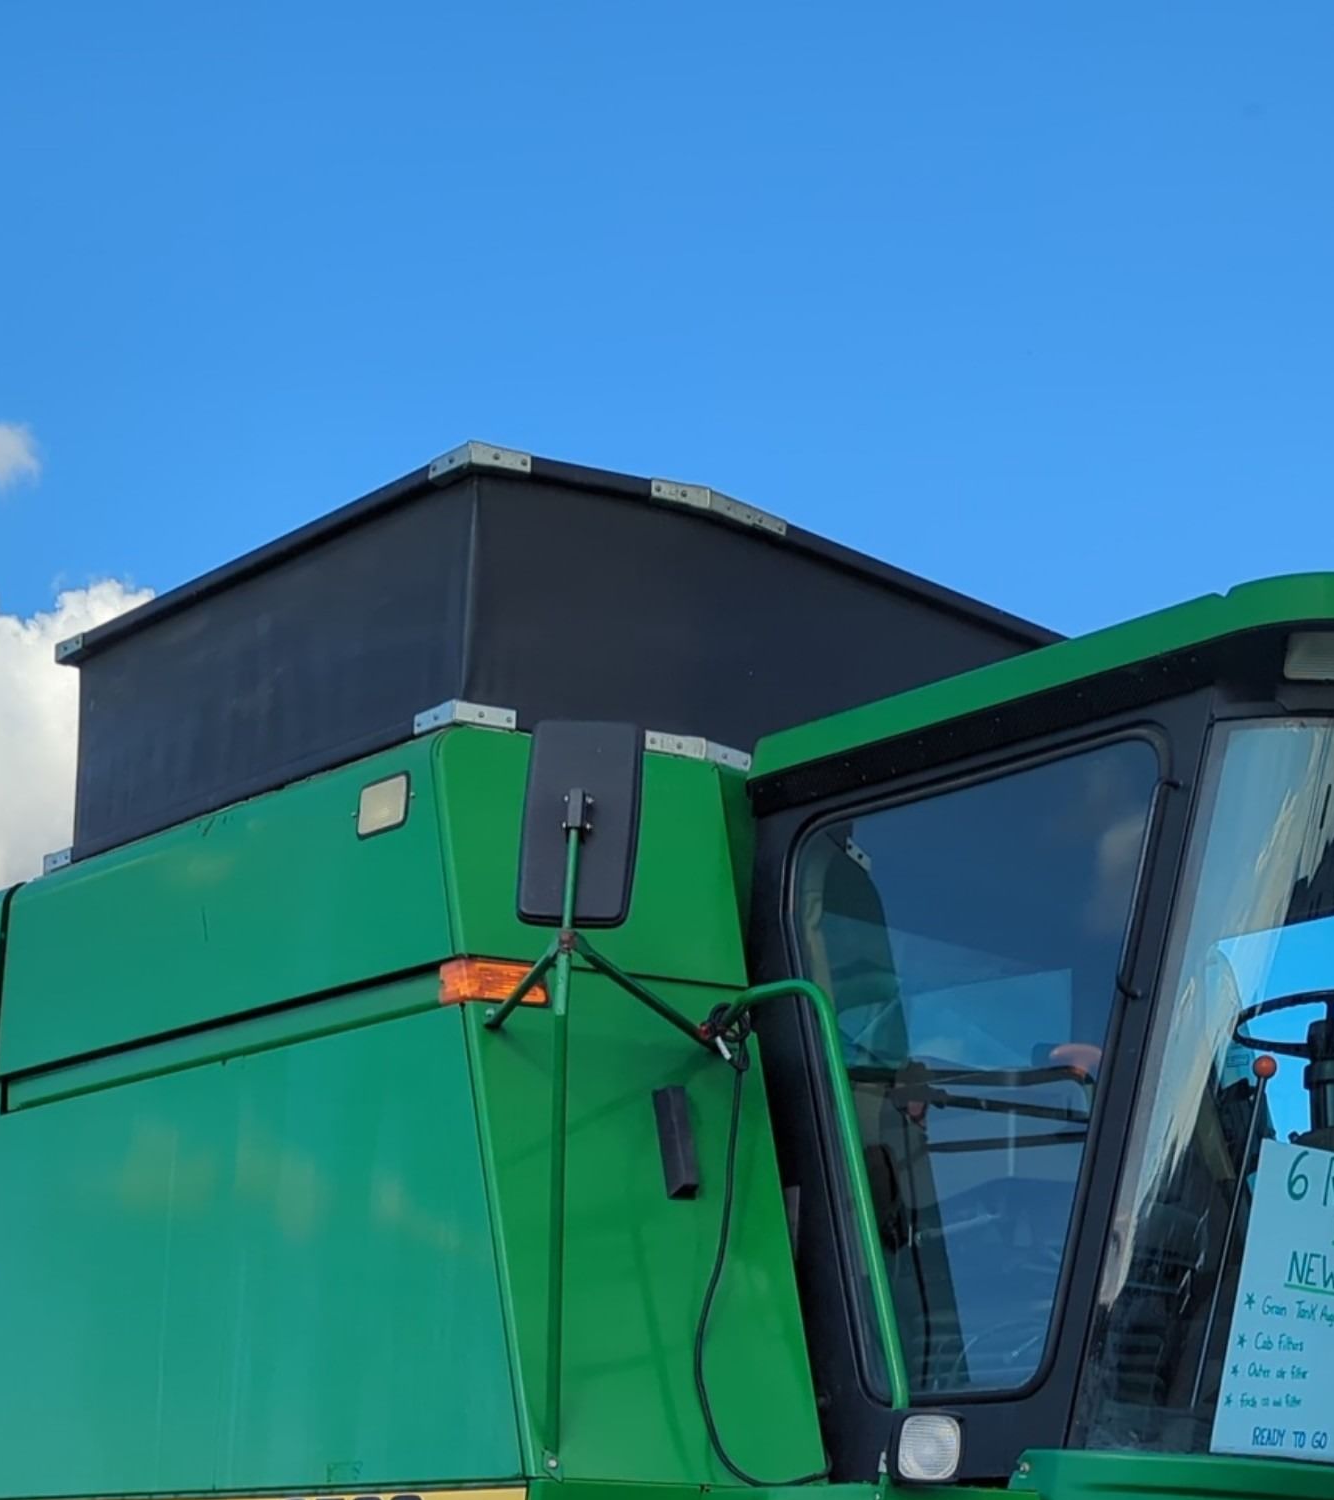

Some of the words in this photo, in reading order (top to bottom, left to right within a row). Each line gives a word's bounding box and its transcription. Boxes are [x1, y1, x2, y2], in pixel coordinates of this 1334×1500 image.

[1287, 1150, 1309, 1200] 6
[1255, 1332, 1273, 1350] Cab
[1252, 1426, 1286, 1447] READY
[1293, 1431, 1306, 1448] TO
[1311, 1432, 1328, 1449] GO
